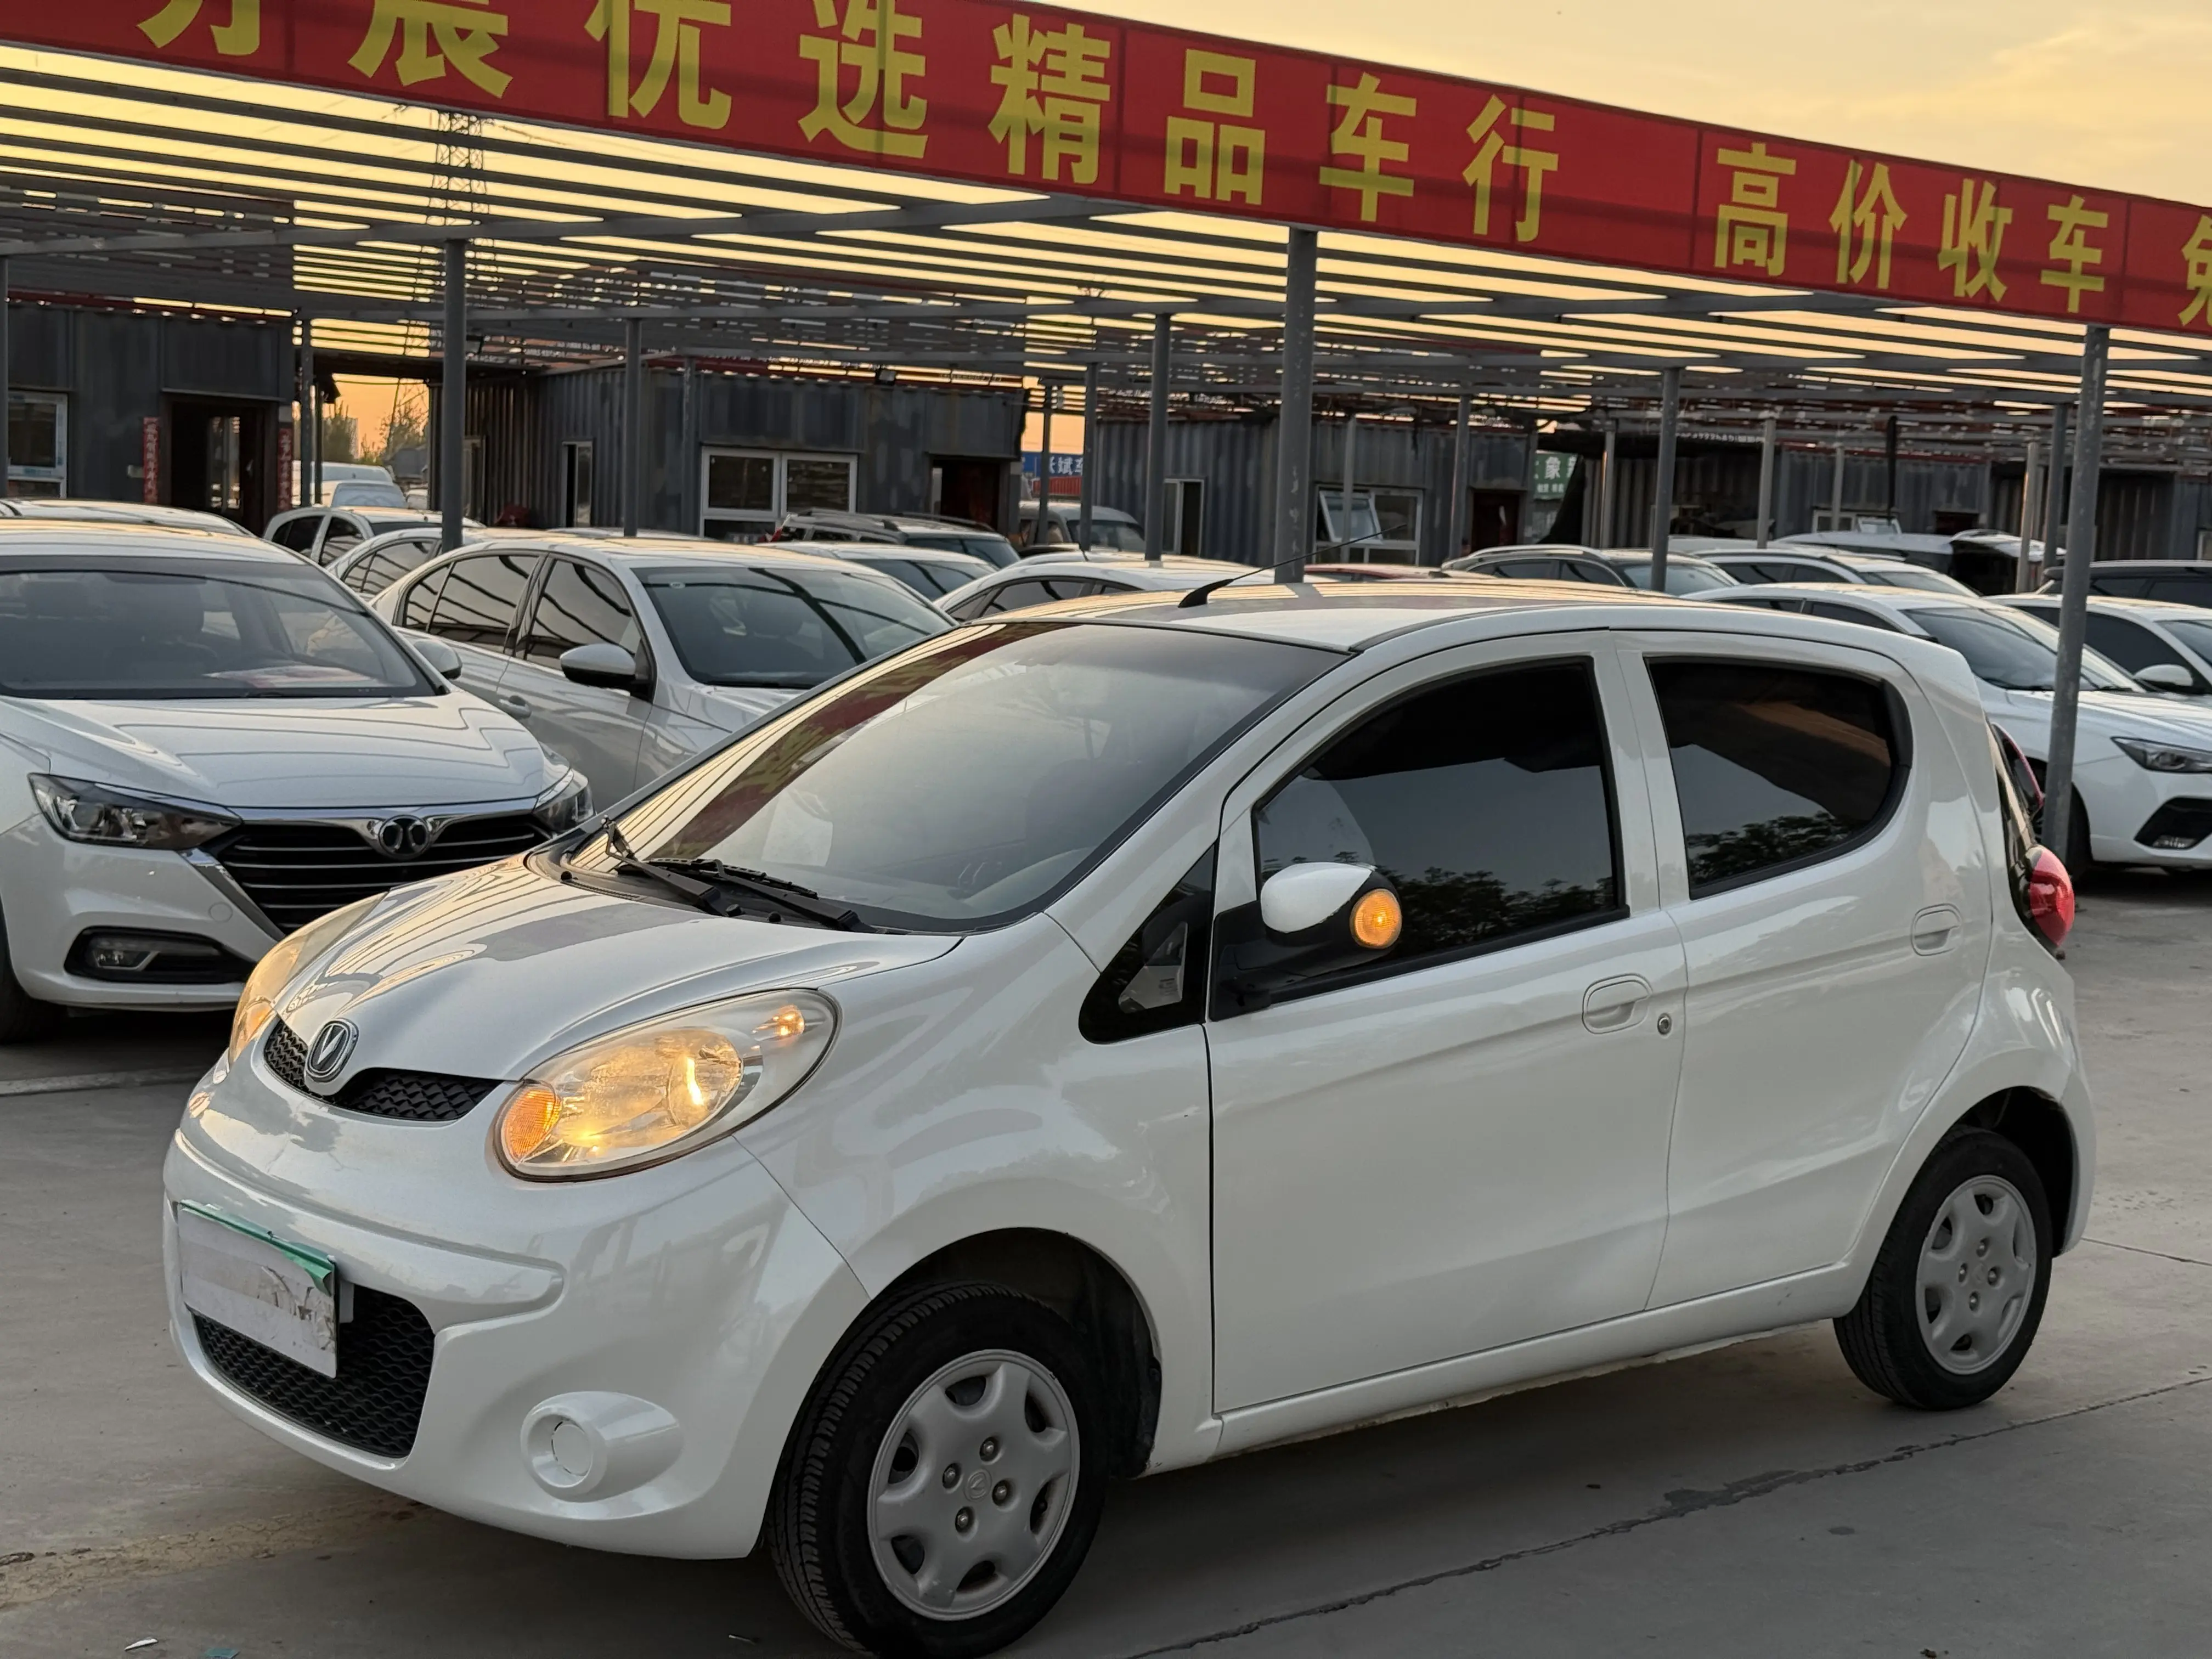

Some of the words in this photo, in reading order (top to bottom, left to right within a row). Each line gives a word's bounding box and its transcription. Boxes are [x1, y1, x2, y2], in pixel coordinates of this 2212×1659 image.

[137, 0, 1559, 242] 优选精品车行
